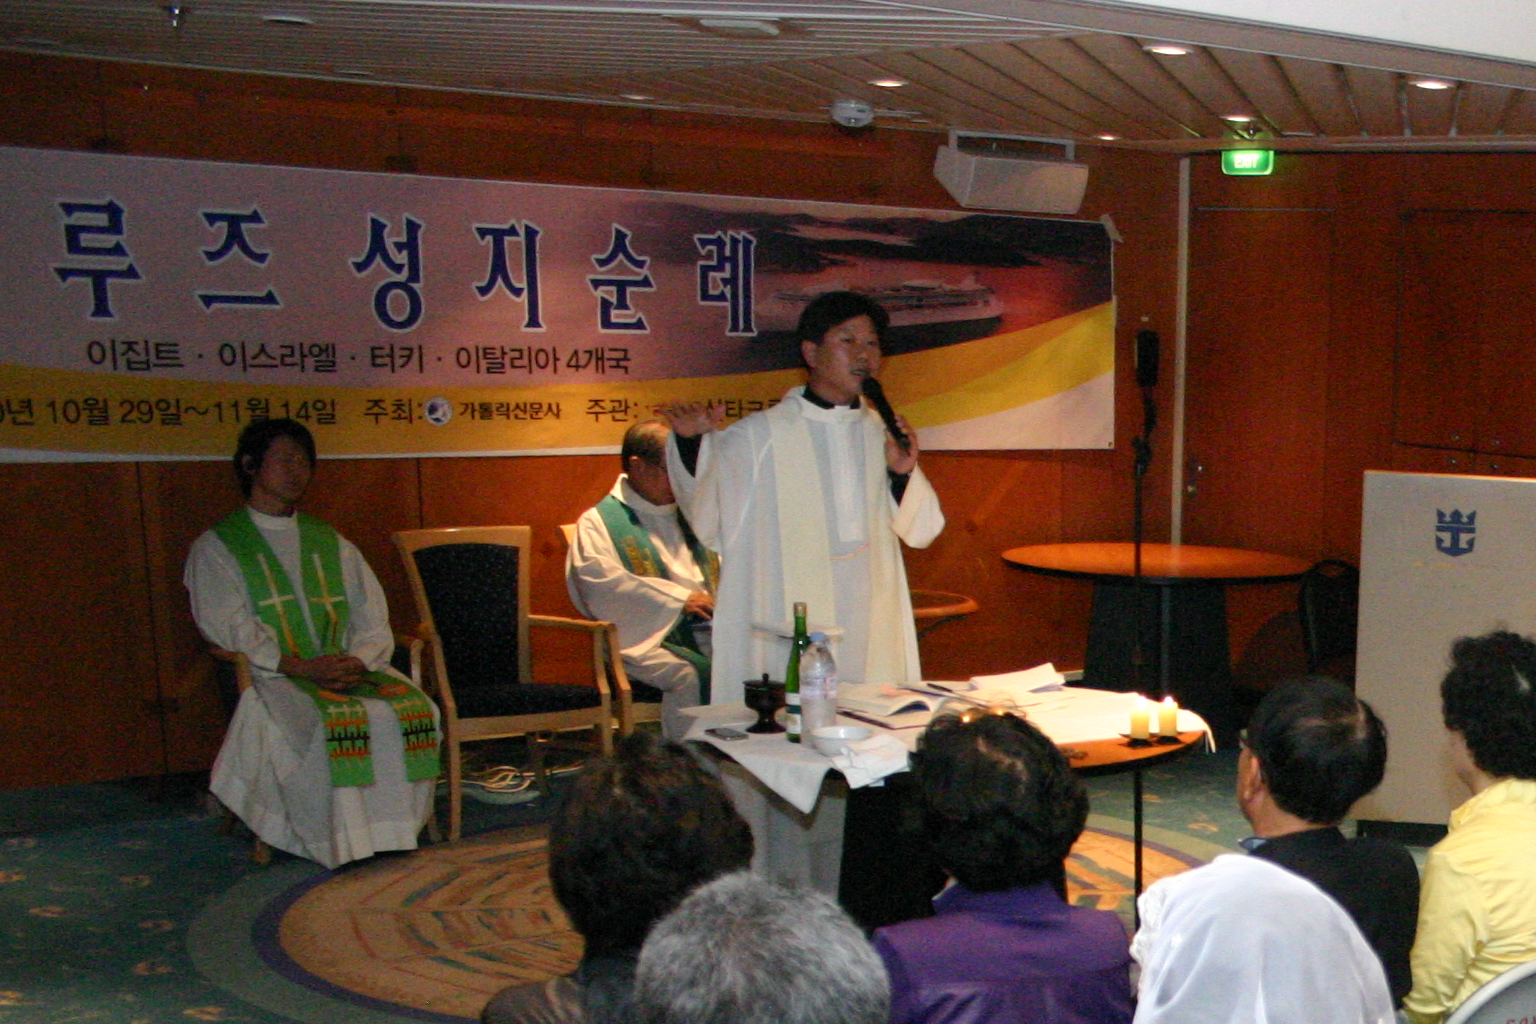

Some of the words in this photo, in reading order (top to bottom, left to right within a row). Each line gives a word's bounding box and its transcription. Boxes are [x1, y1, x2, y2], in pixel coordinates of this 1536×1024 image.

[87, 339, 185, 372] 이집트
[217, 341, 338, 373] 이스라엘
[370, 344, 425, 374] 터키
[455, 344, 560, 375] 이탈리아
[566, 346, 632, 375] 4개국
[46, 397, 111, 427] 10월
[282, 398, 337, 426] 14일
